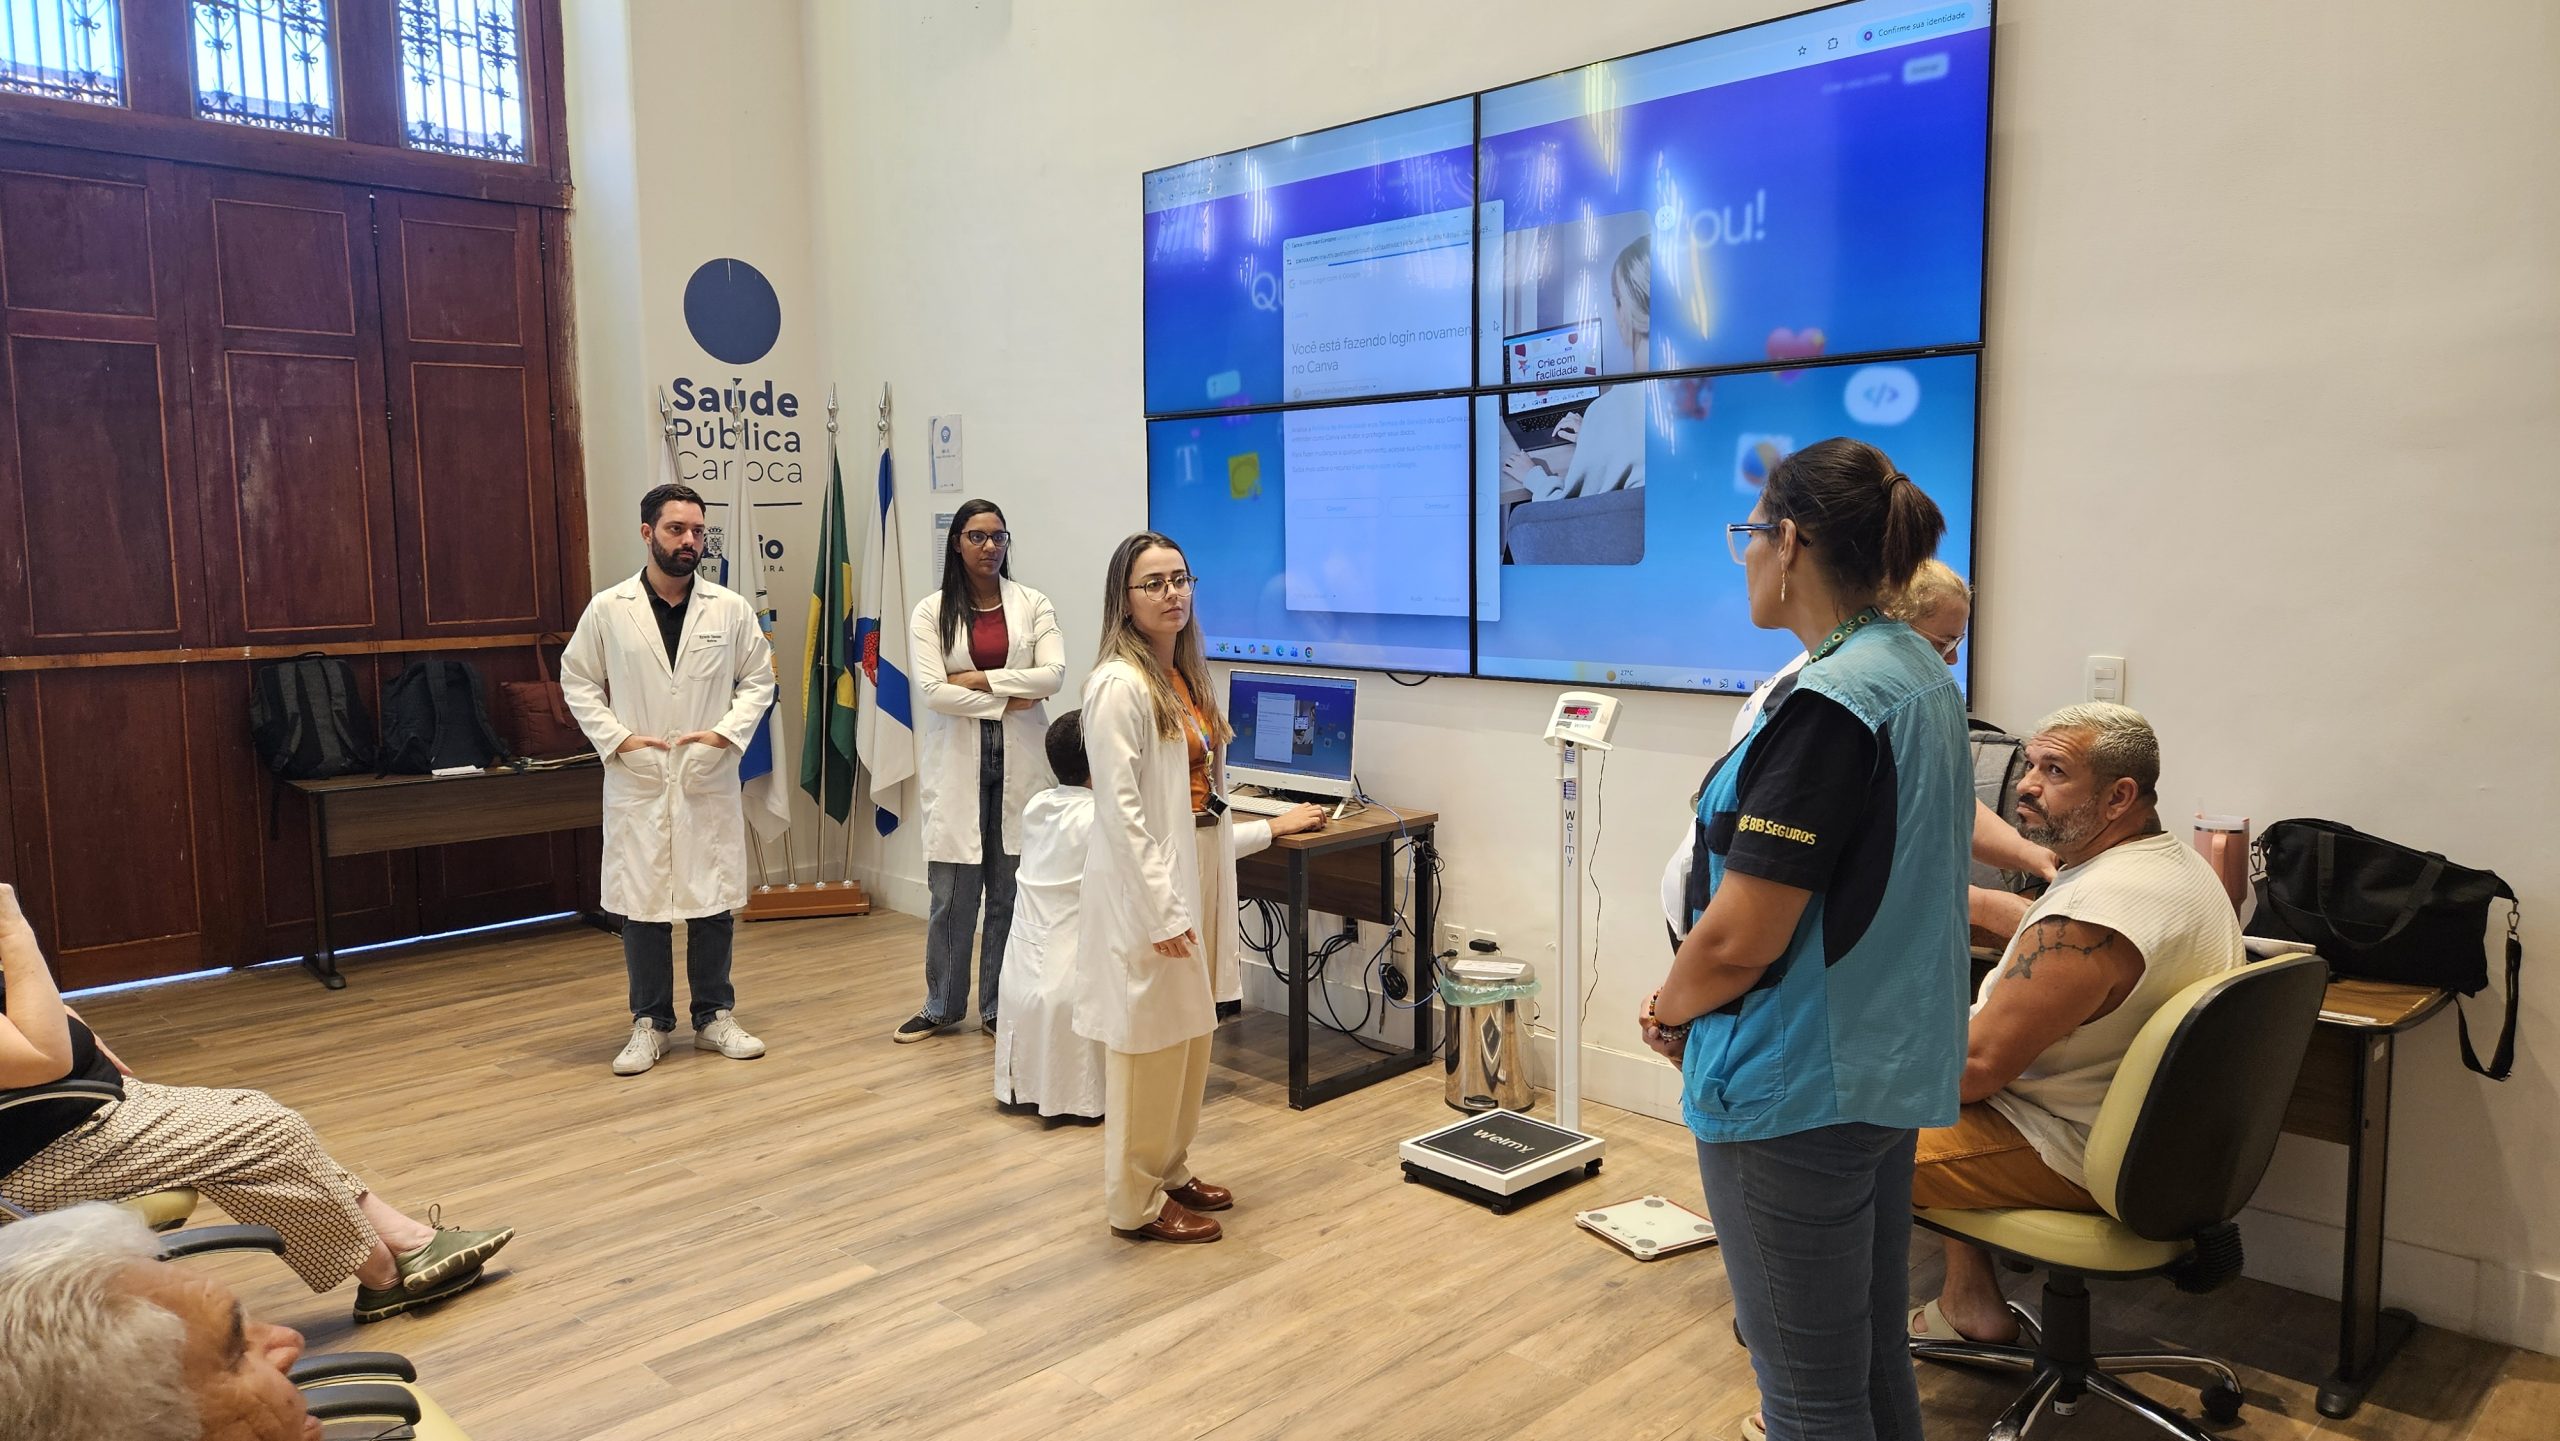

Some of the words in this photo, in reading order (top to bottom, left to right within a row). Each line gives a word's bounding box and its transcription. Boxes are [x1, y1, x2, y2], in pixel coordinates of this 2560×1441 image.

[1878, 25, 1911, 37] Confirme
[1912, 21, 1925, 30] sua
[1926, 11, 1966, 26] identidade
[1292, 341, 1317, 355] Você
[1319, 338, 1341, 352] está
[1343, 334, 1387, 350] fazendo
[1389, 329, 1416, 347] login
[1418, 325, 1484, 341] novamene
[1292, 364, 1305, 375] no
[1307, 360, 1339, 374] Canva
[1536, 364, 1578, 381] facilidade
[1537, 358, 1556, 369] Crie
[1556, 354, 1576, 365] com
[672, 377, 799, 418] Saúde
[672, 417, 801, 453] Pública
[678, 450, 802, 483] Caroca
[758, 534, 784, 559] io
[1564, 808, 1576, 868] Welmy
[1473, 1129, 1536, 1154] Welmy
